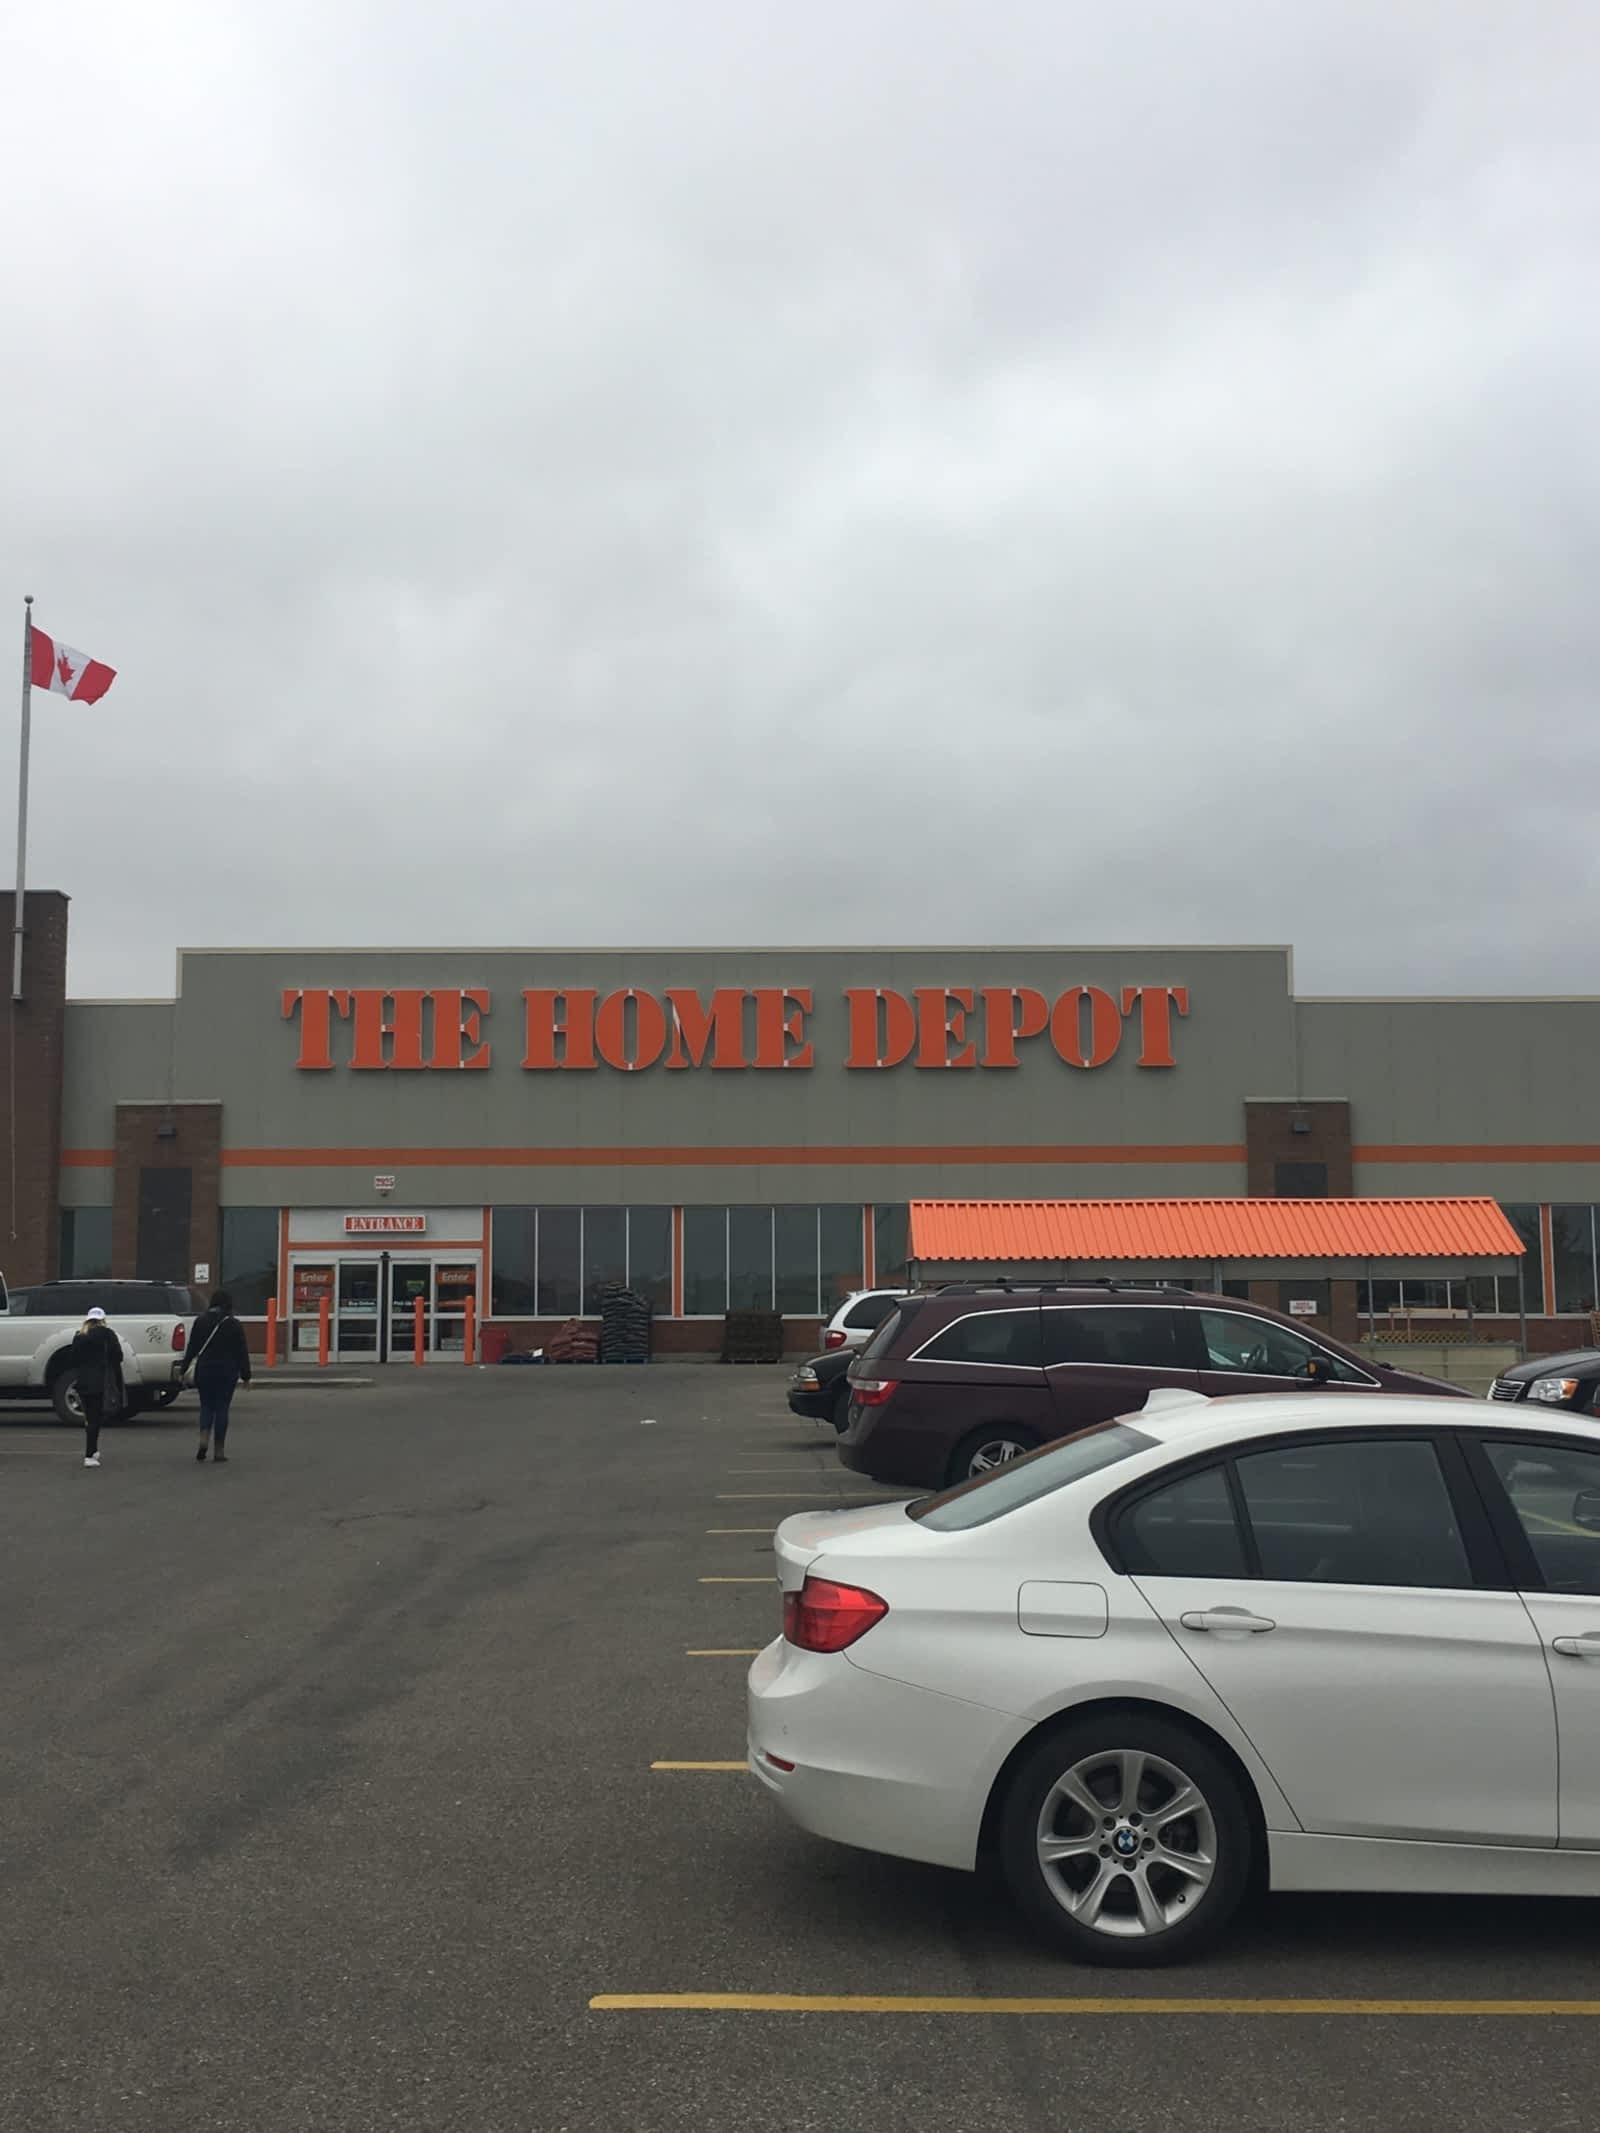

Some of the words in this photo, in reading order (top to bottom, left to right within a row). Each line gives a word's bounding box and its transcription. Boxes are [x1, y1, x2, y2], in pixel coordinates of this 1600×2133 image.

[281, 988, 490, 1069] THE
[520, 987, 814, 1070] HOME
[842, 985, 1190, 1068] DEPOT
[351, 1217, 419, 1230] ENTRANCE
